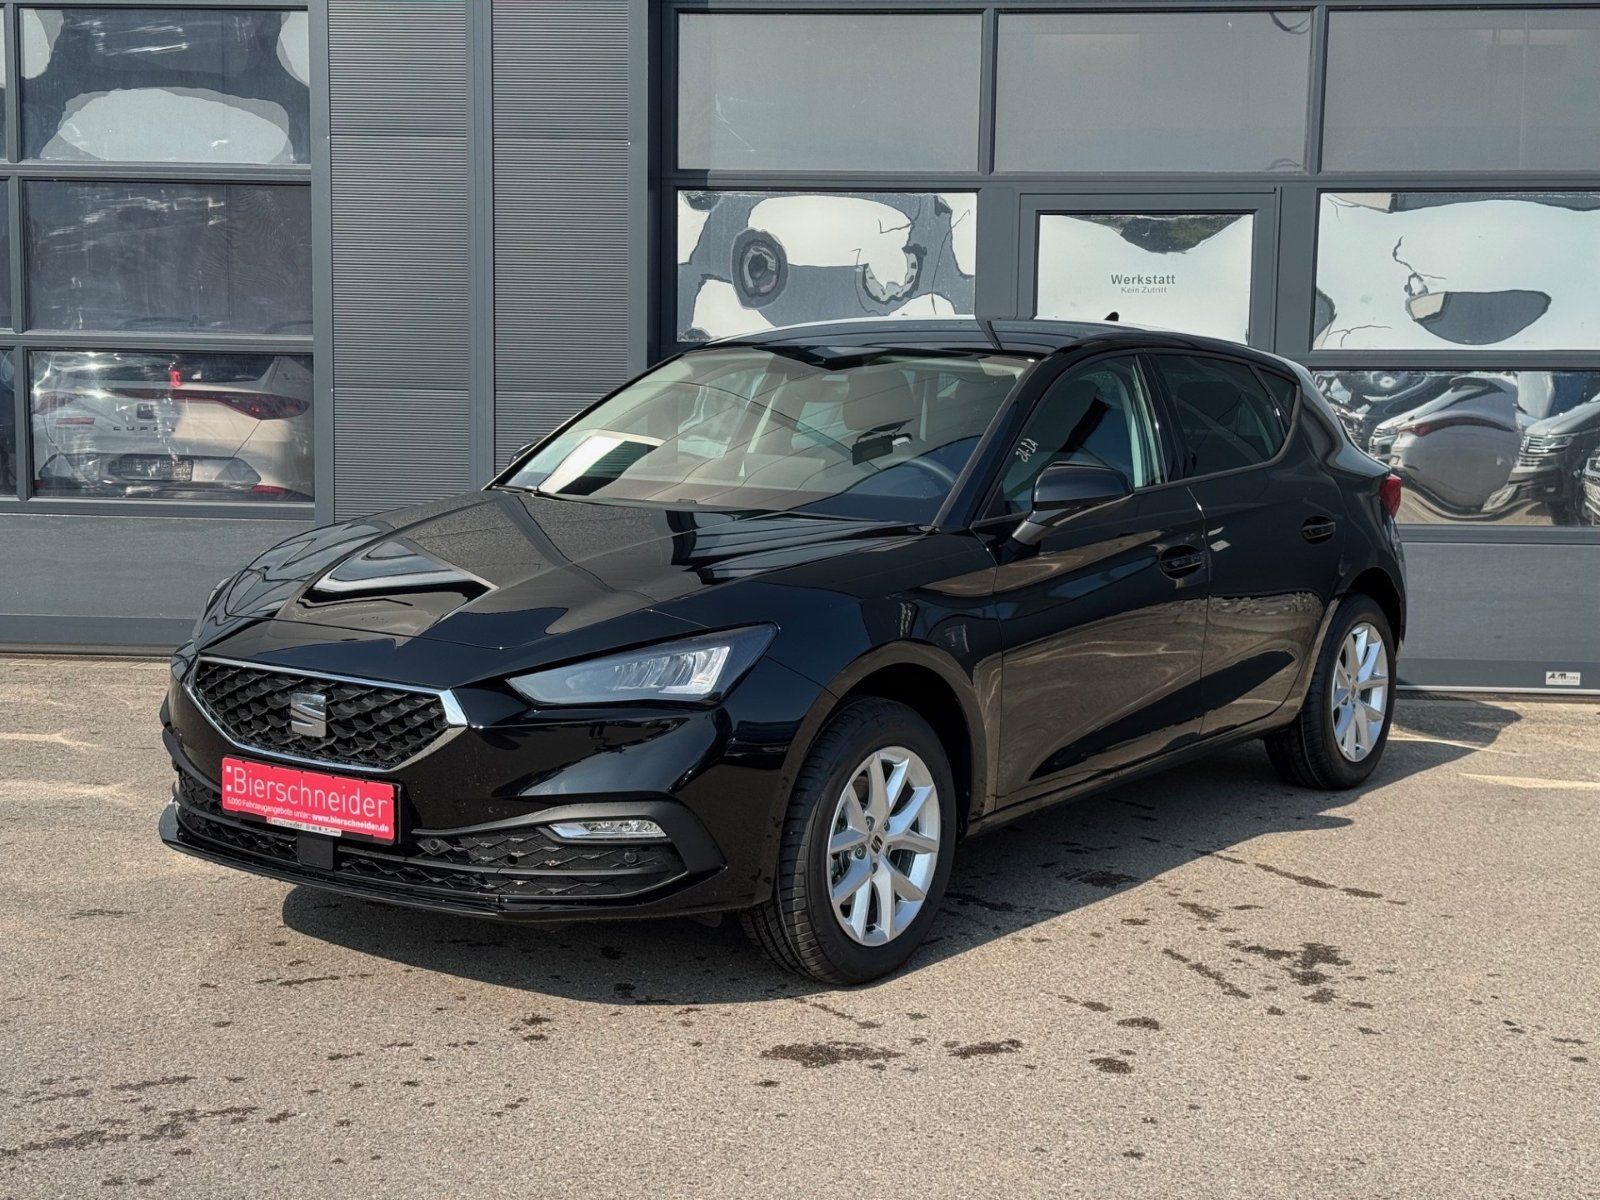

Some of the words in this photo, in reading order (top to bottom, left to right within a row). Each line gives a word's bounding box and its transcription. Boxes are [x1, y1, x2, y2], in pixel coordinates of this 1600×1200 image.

[1110, 274, 1176, 285] Werkstatt
[233, 767, 388, 819] Bierschneider
[312, 813, 390, 833] www.bierschneider.de
